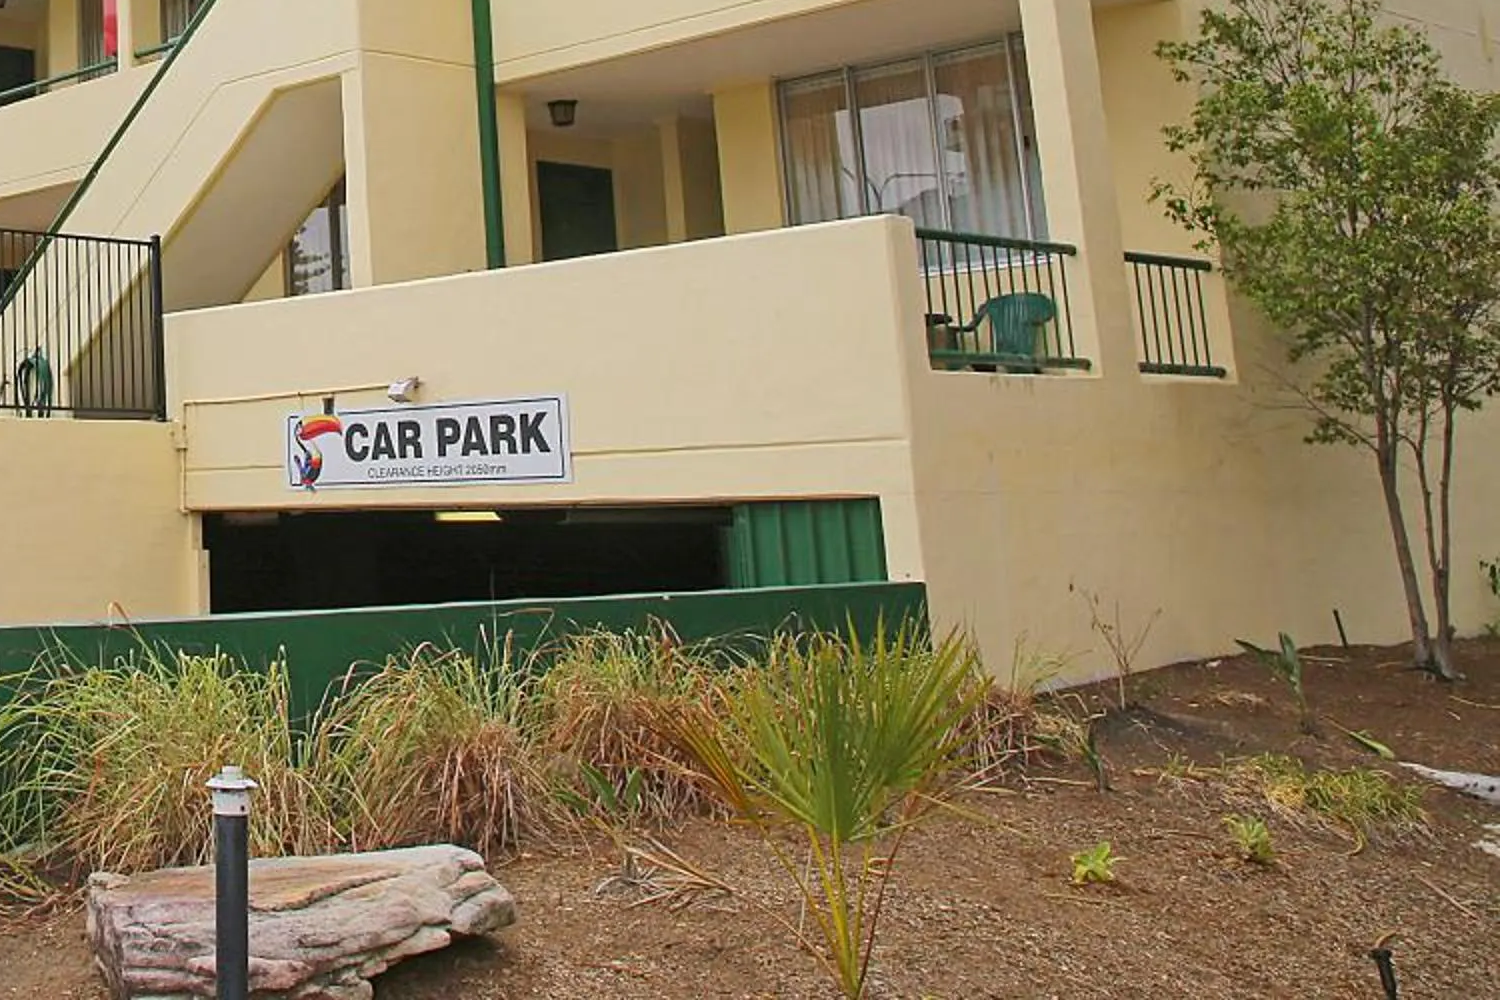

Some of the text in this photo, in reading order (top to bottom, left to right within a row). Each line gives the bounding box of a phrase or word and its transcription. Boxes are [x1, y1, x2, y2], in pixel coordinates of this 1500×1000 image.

[345, 411, 551, 462] CAR PARK
[367, 466, 425, 479] CLEARANCE
[427, 464, 463, 477] HEIGHT
